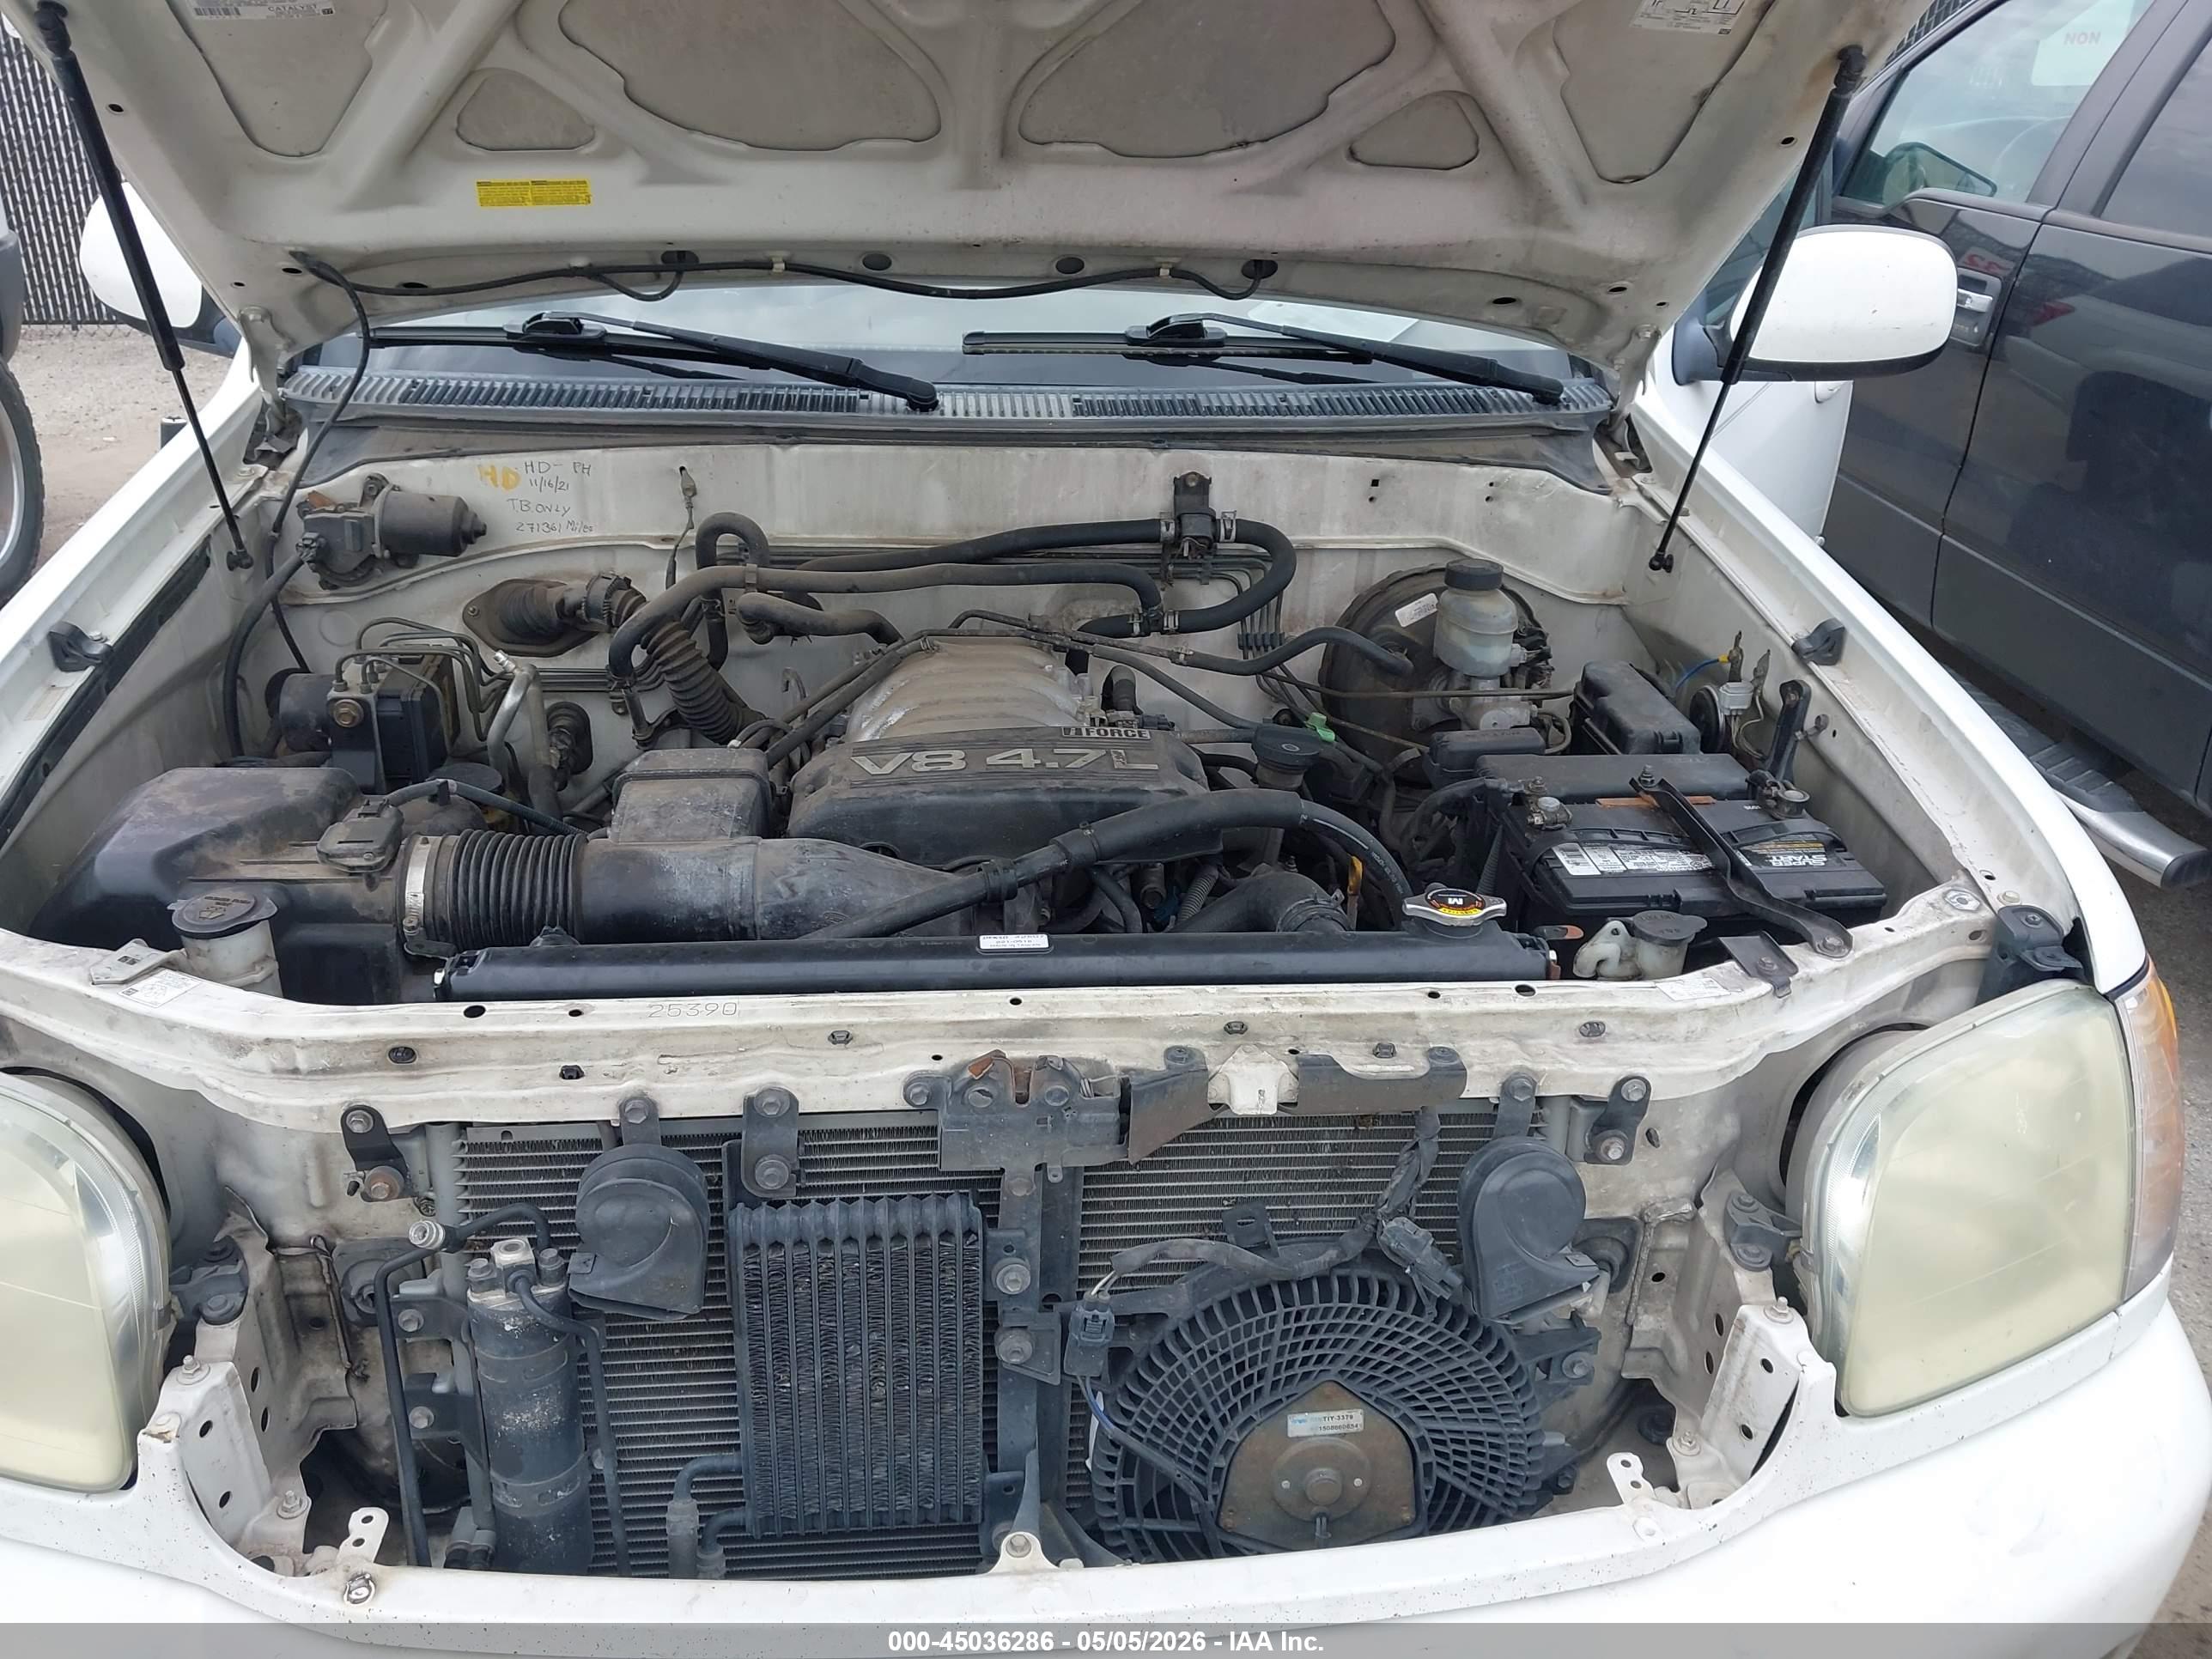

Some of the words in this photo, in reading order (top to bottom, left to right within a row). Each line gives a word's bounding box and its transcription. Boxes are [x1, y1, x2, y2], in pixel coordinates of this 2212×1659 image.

[850, 749, 967, 775] V8
[986, 748, 1158, 770] 4.7L
[647, 1002, 738, 1018] 25390
